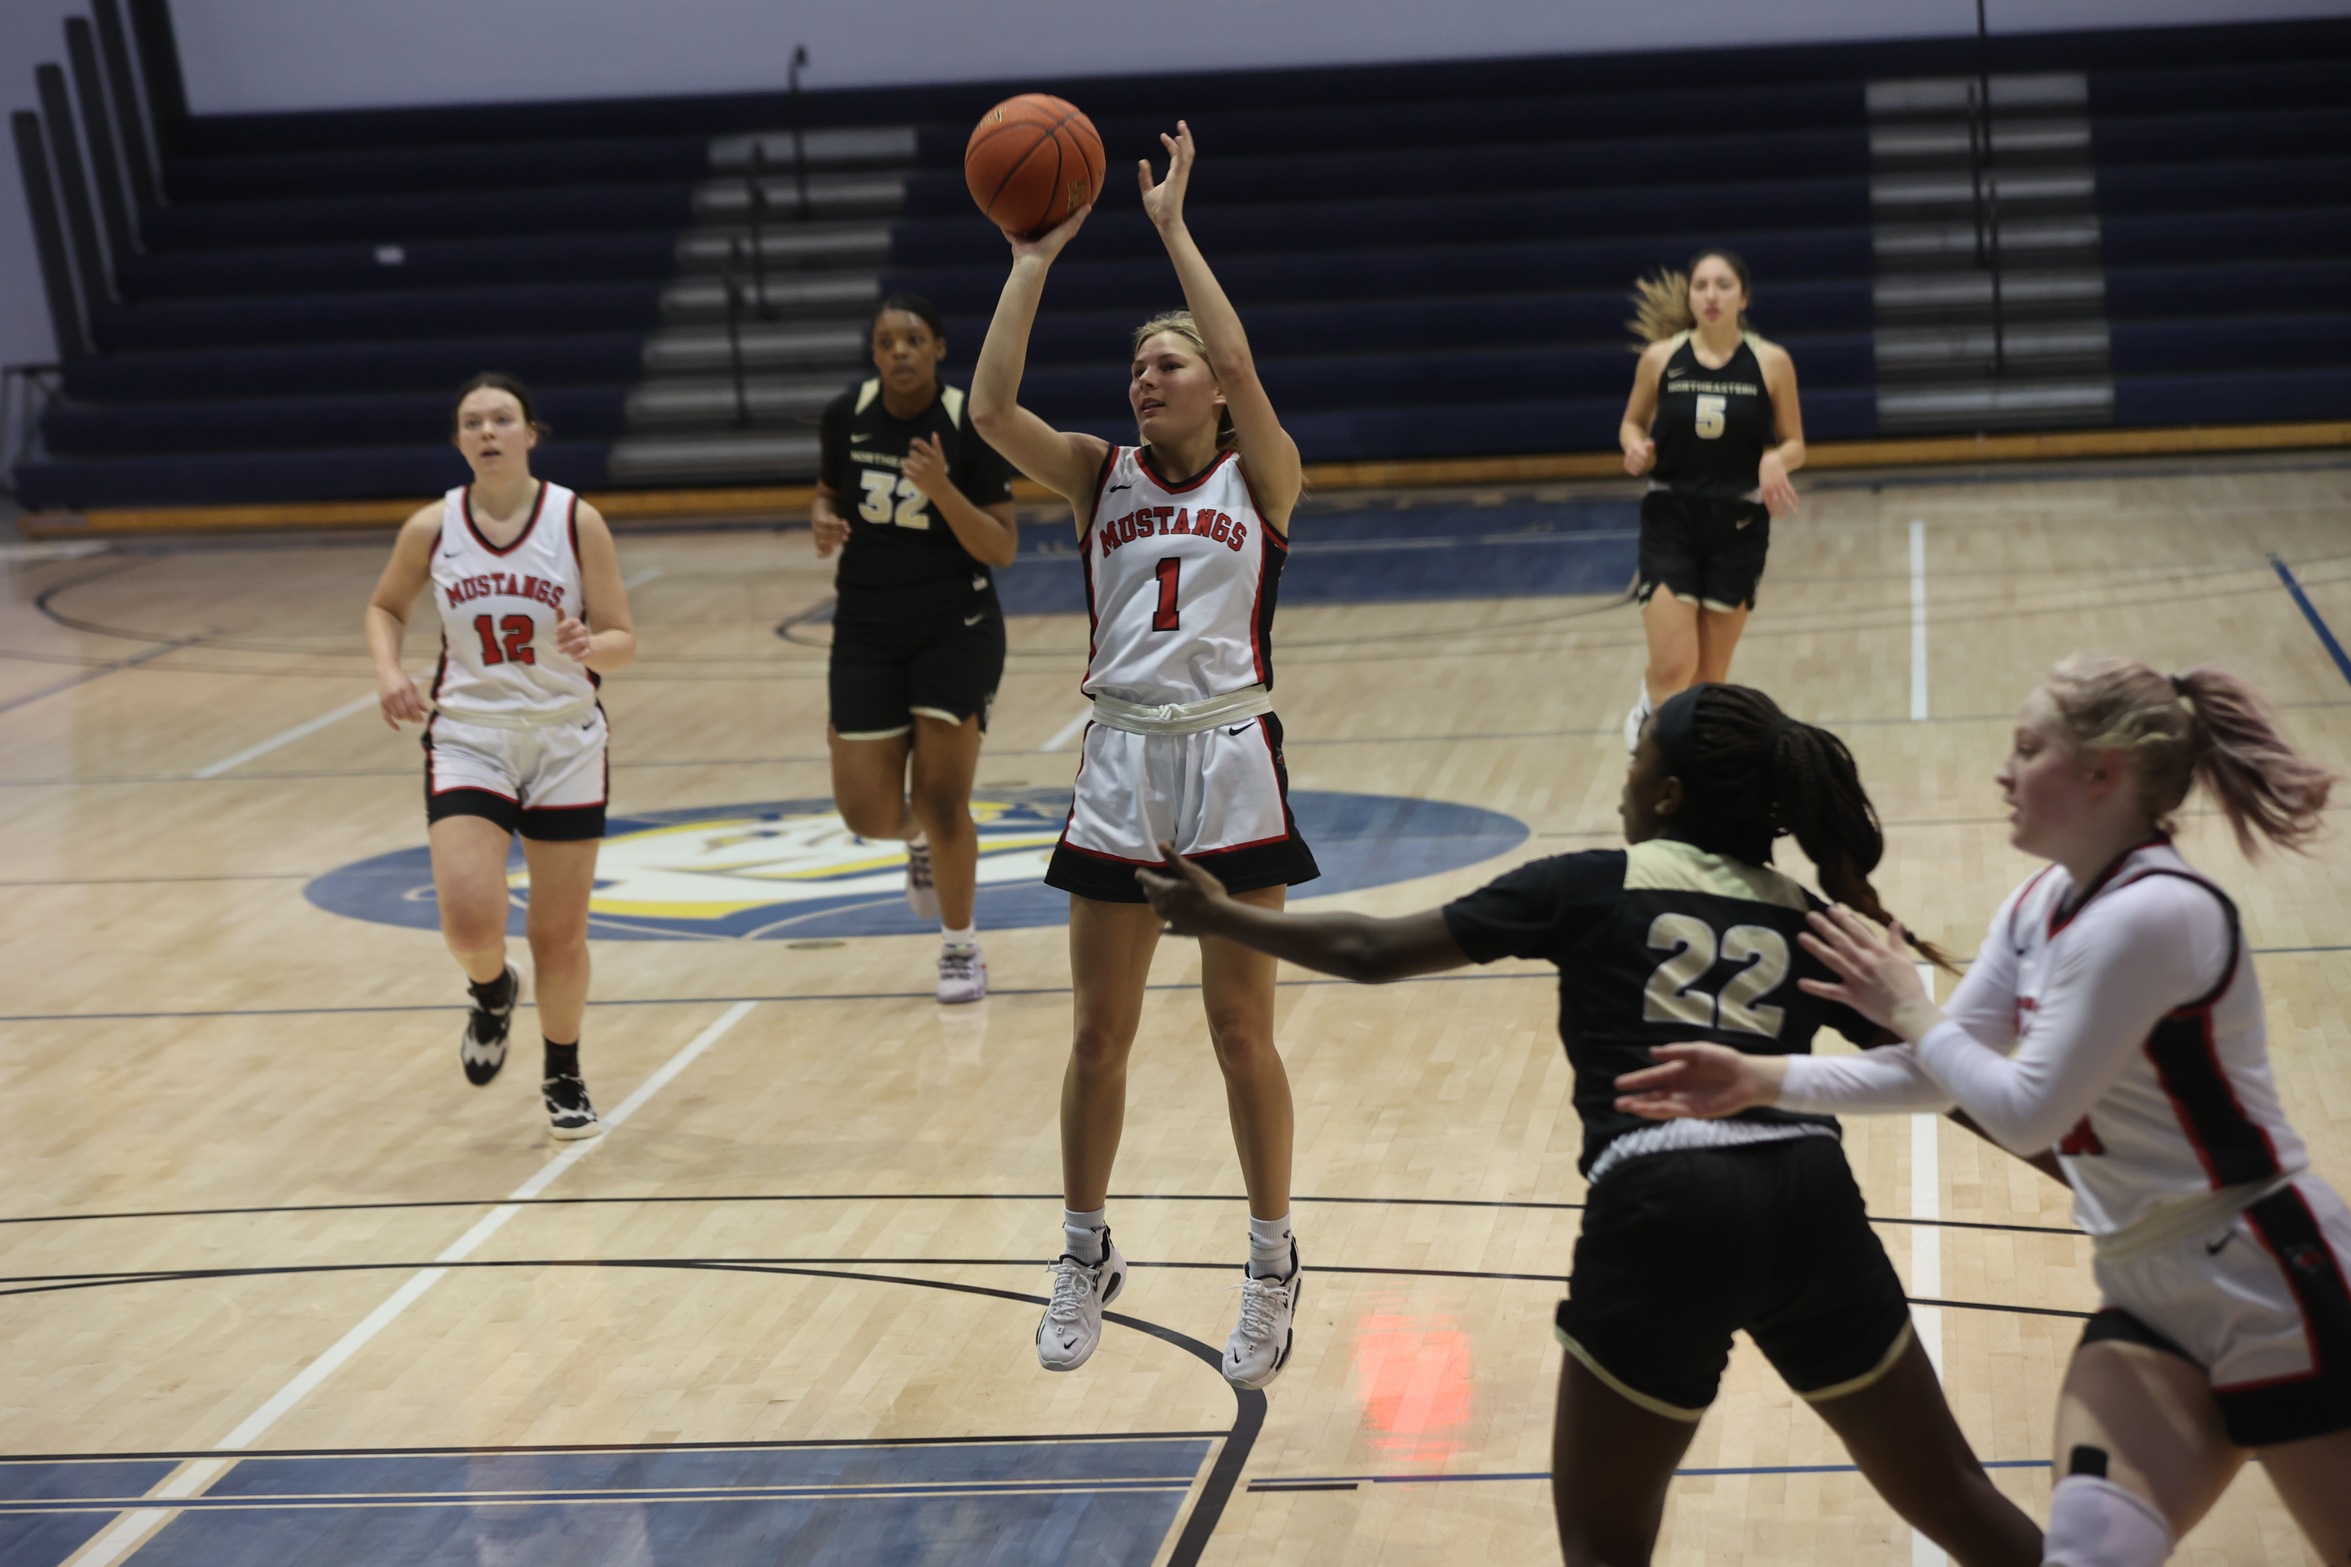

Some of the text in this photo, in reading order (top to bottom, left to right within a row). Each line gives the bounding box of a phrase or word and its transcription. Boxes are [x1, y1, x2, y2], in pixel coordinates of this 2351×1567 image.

[1695, 393, 1727, 440] 5
[858, 469, 930, 530] 32
[1099, 506, 1248, 559] MUSTANGS
[445, 572, 566, 609] MUSTANGS
[1152, 556, 1181, 632] 1
[474, 614, 536, 666] 12
[1643, 912, 1790, 1039] 22
